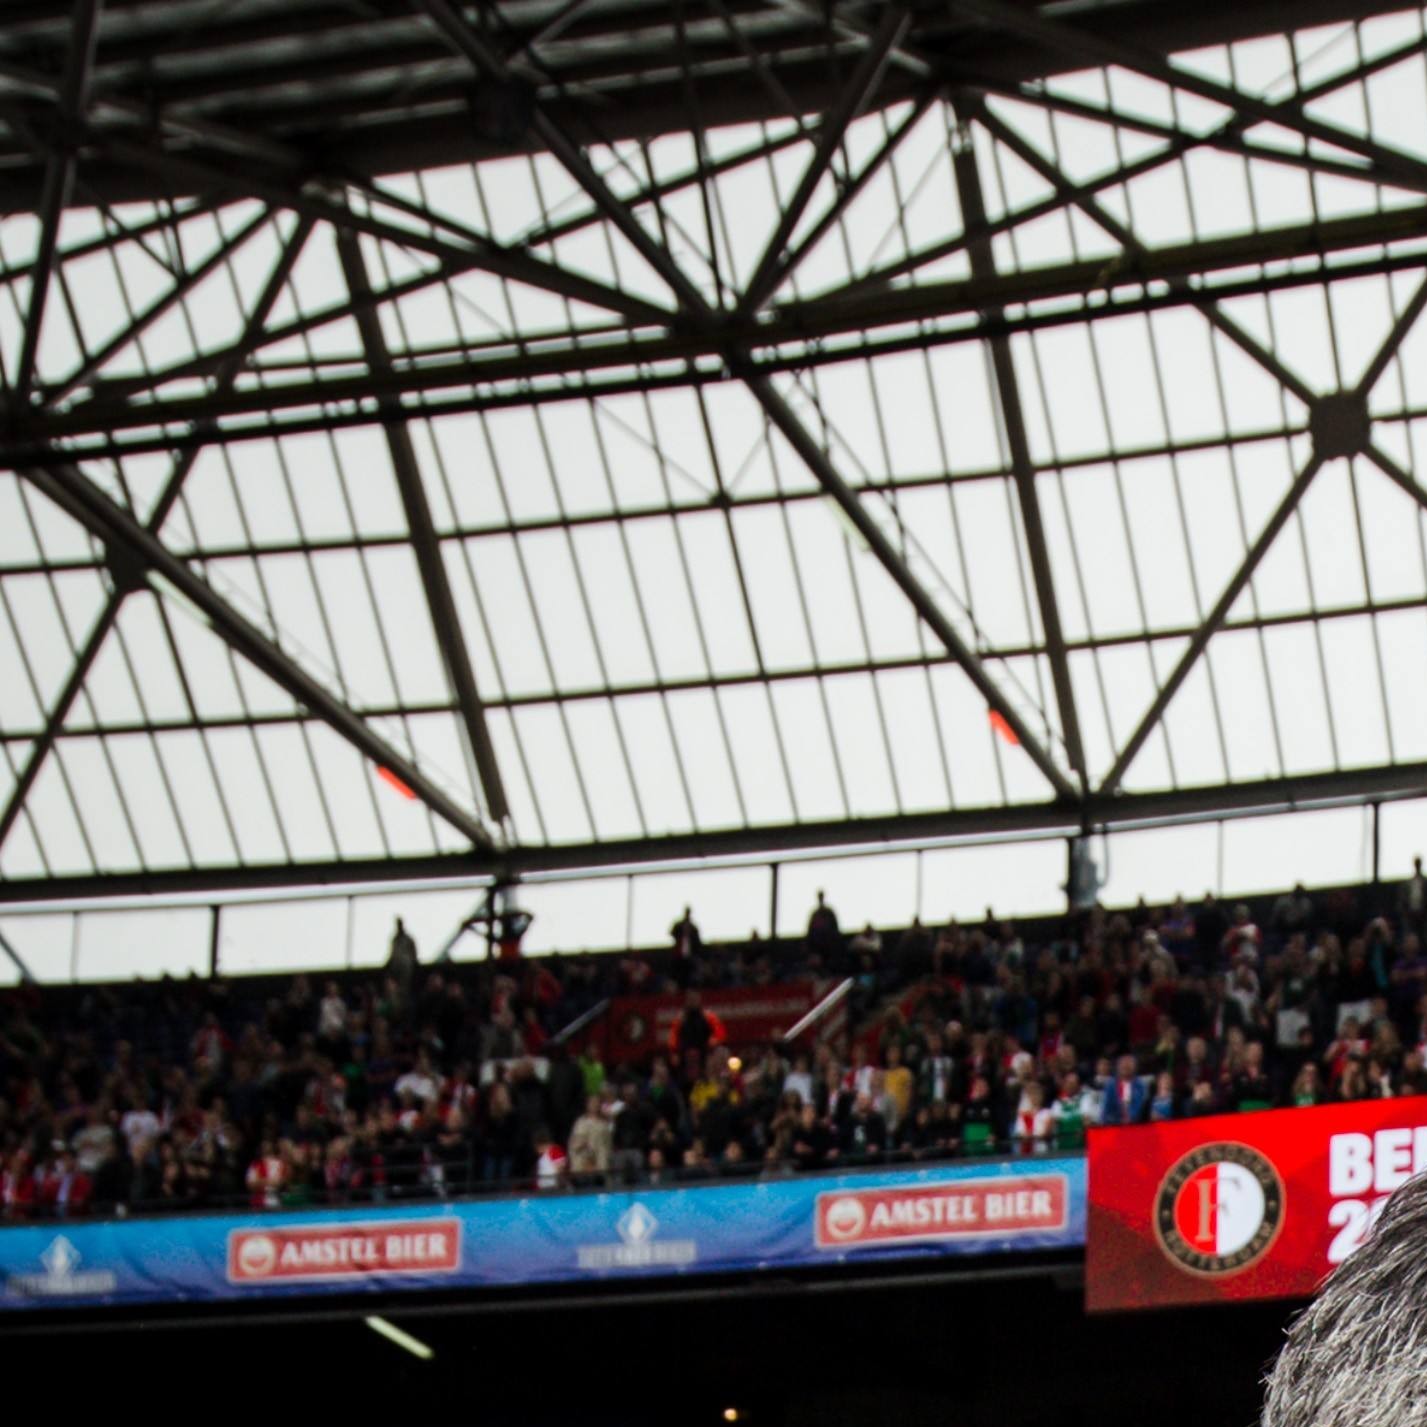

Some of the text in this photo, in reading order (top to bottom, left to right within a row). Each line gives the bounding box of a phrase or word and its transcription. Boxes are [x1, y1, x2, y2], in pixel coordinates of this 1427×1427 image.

[870, 1190, 1051, 1229] AMSTEL BIER
[281, 1233, 446, 1266] AMSTEL BIER
